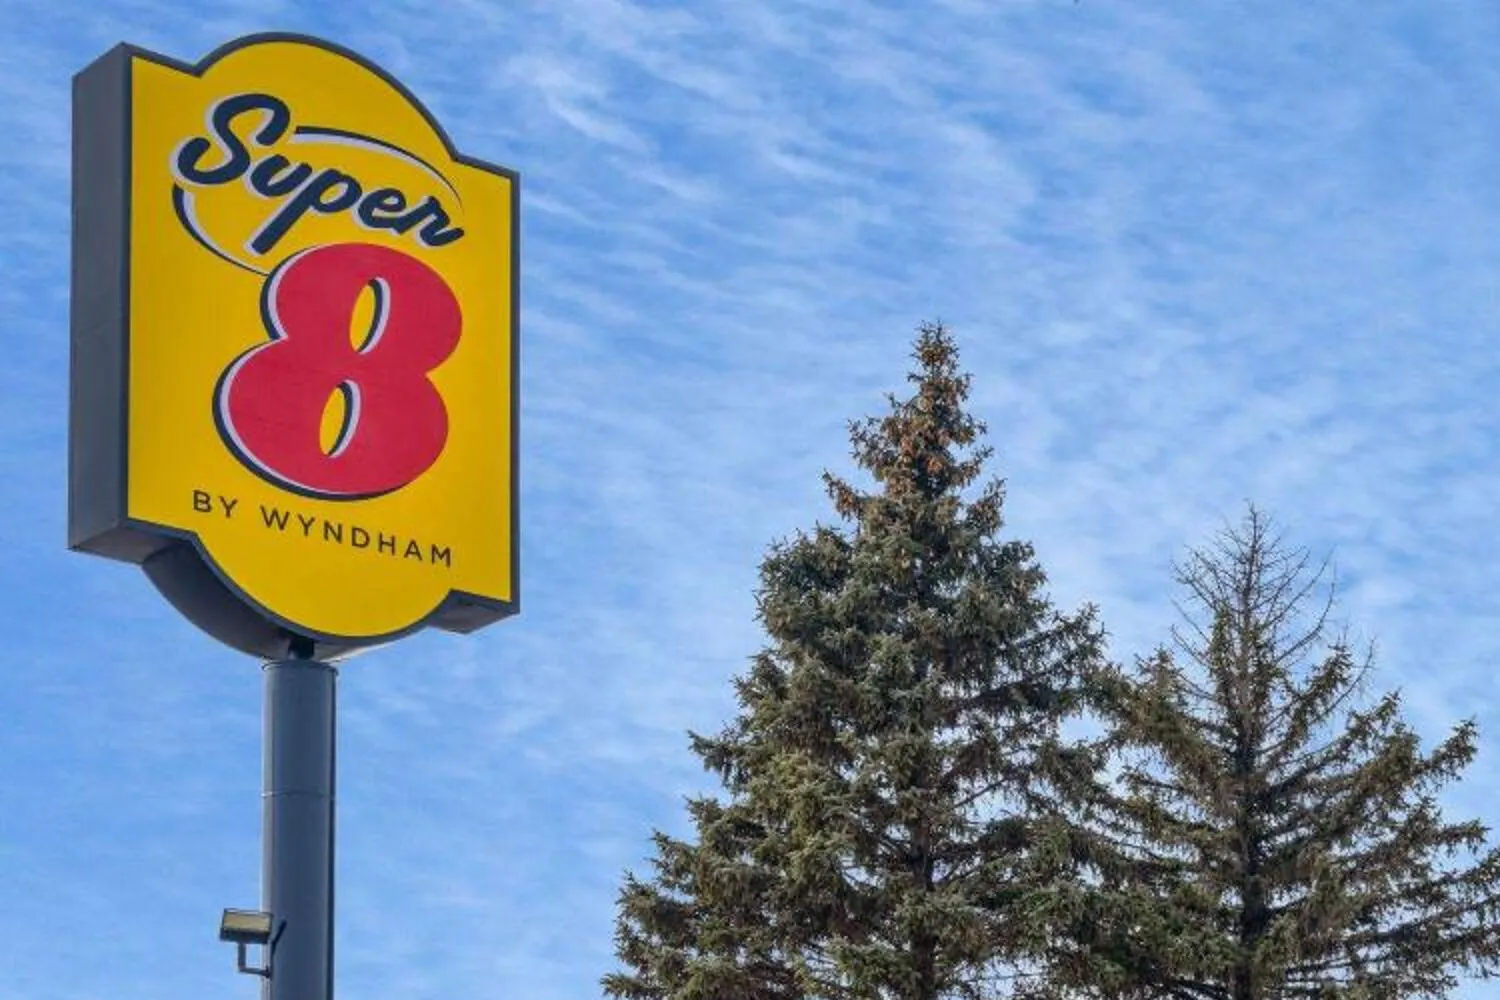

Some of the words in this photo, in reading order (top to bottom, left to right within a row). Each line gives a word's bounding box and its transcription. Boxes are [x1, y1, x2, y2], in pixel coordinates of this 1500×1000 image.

[172, 93, 465, 255] Super
[212, 242, 464, 501] 8
[192, 489, 239, 519] BY
[260, 504, 452, 568] WYNDHAM
